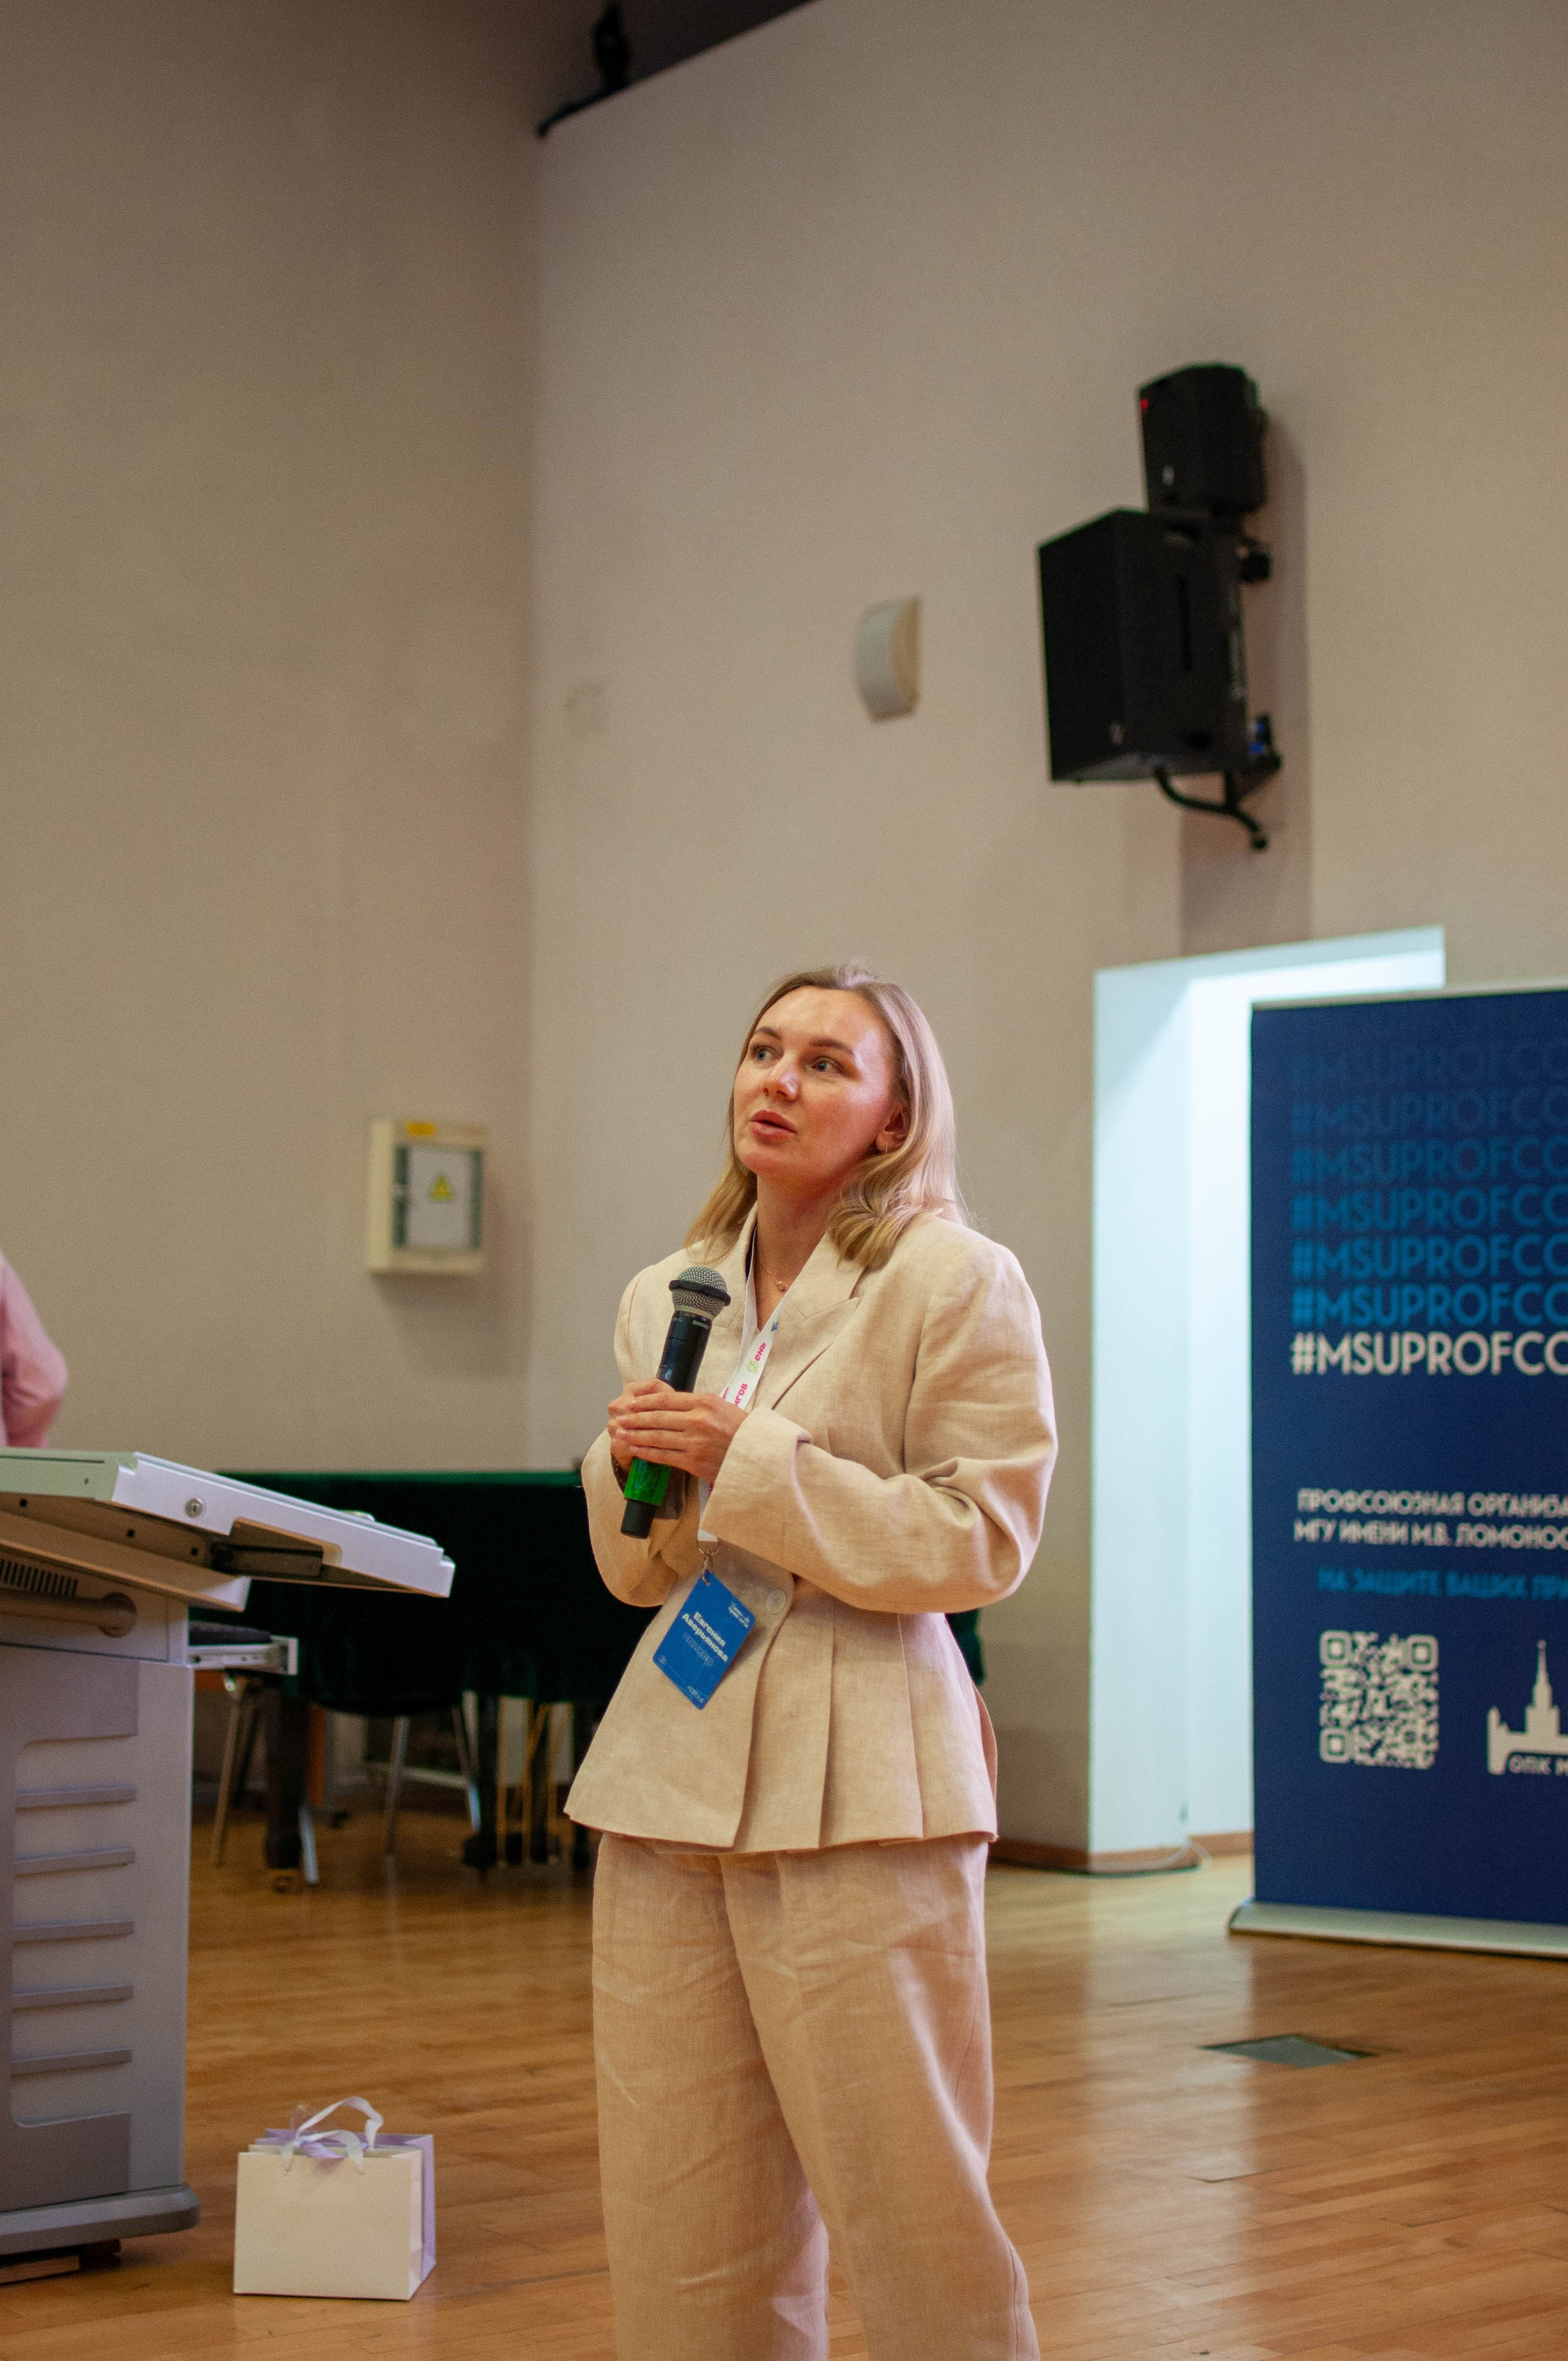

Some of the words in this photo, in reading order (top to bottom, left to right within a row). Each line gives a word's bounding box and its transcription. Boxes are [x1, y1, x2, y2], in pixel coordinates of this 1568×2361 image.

[1291, 1331, 1568, 1375] #MSUPROFCO
[682, 1613, 728, 1663] Аверьянова
[693, 1611, 726, 1647] Евгения
